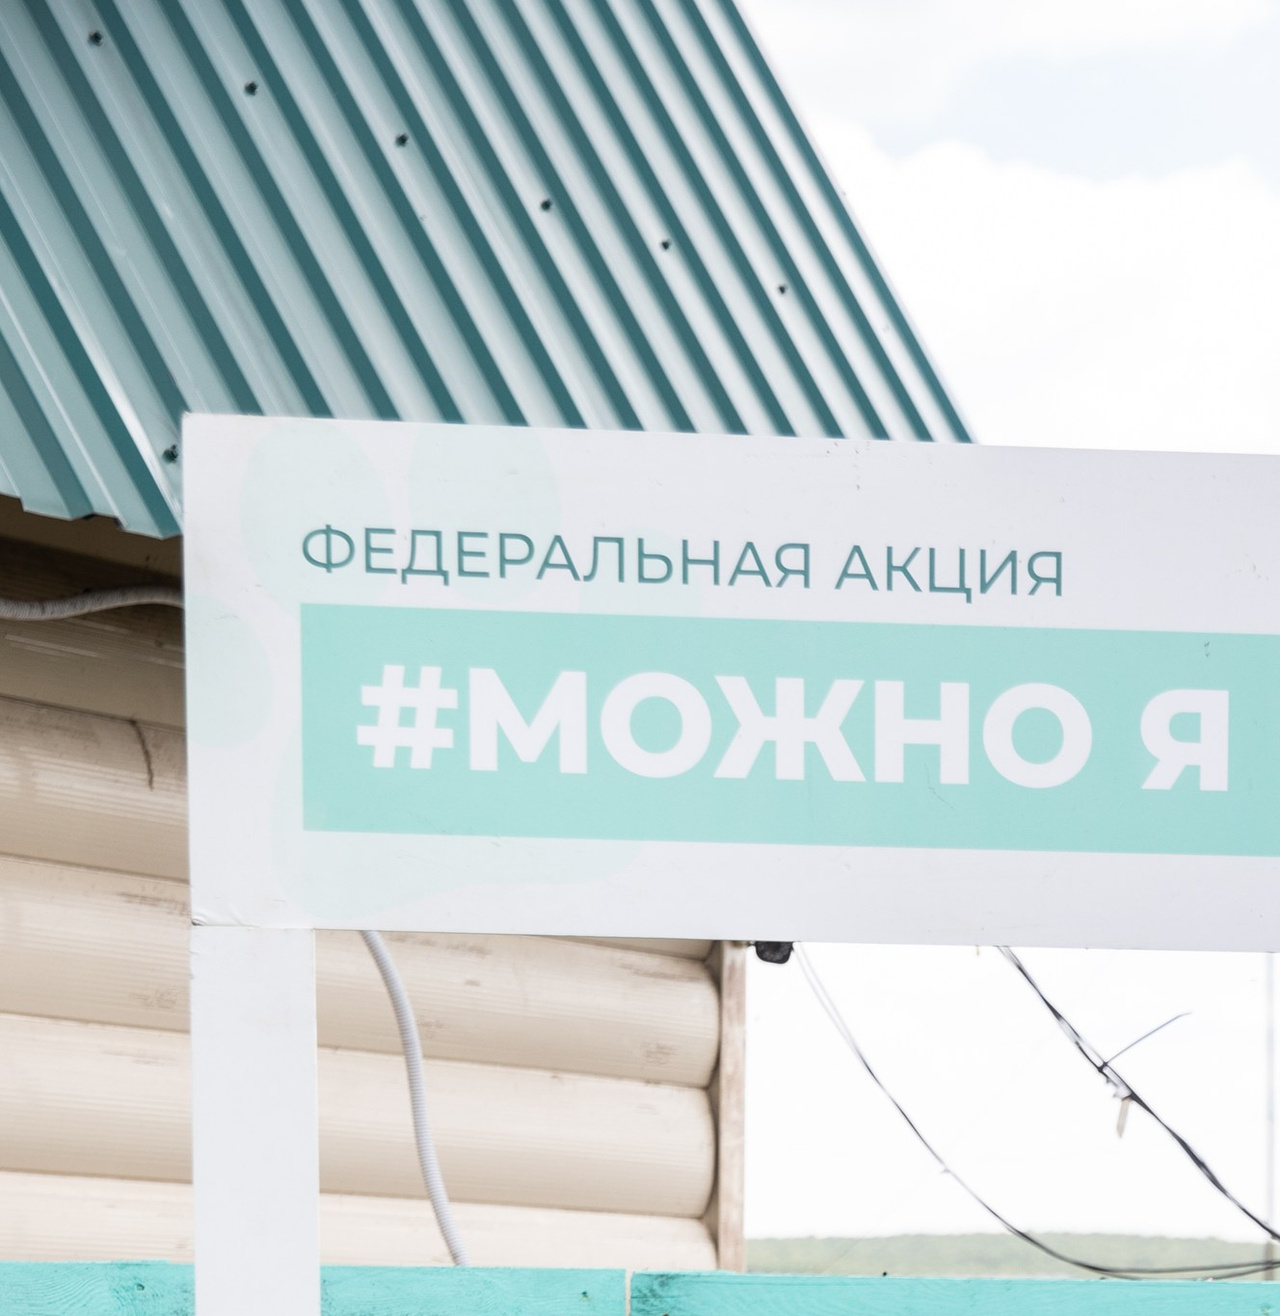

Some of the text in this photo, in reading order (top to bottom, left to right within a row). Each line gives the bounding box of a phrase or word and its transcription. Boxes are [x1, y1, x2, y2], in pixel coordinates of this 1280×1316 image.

[301, 523, 1065, 604] ФЕДЕРАЛЬНАЯ АКЦИЯ
[356, 663, 1094, 789] #МОЖНО
[1139, 689, 1230, 793] Я
